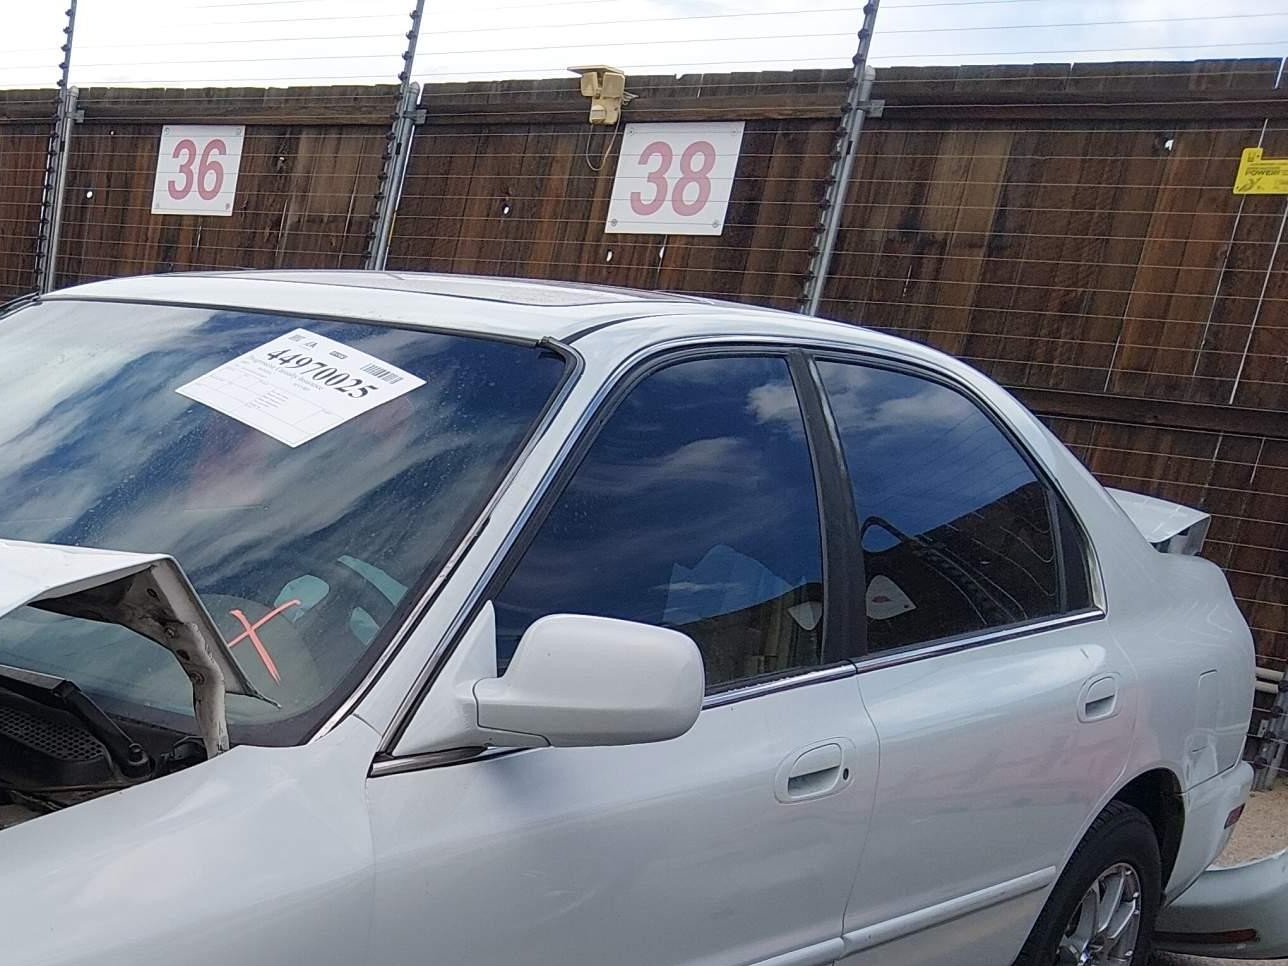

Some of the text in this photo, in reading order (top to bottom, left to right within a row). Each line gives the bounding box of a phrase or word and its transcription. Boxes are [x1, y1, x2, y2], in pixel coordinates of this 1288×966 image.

[168, 139, 227, 200] 36
[630, 141, 716, 216] 38
[267, 349, 378, 398] 44970025
